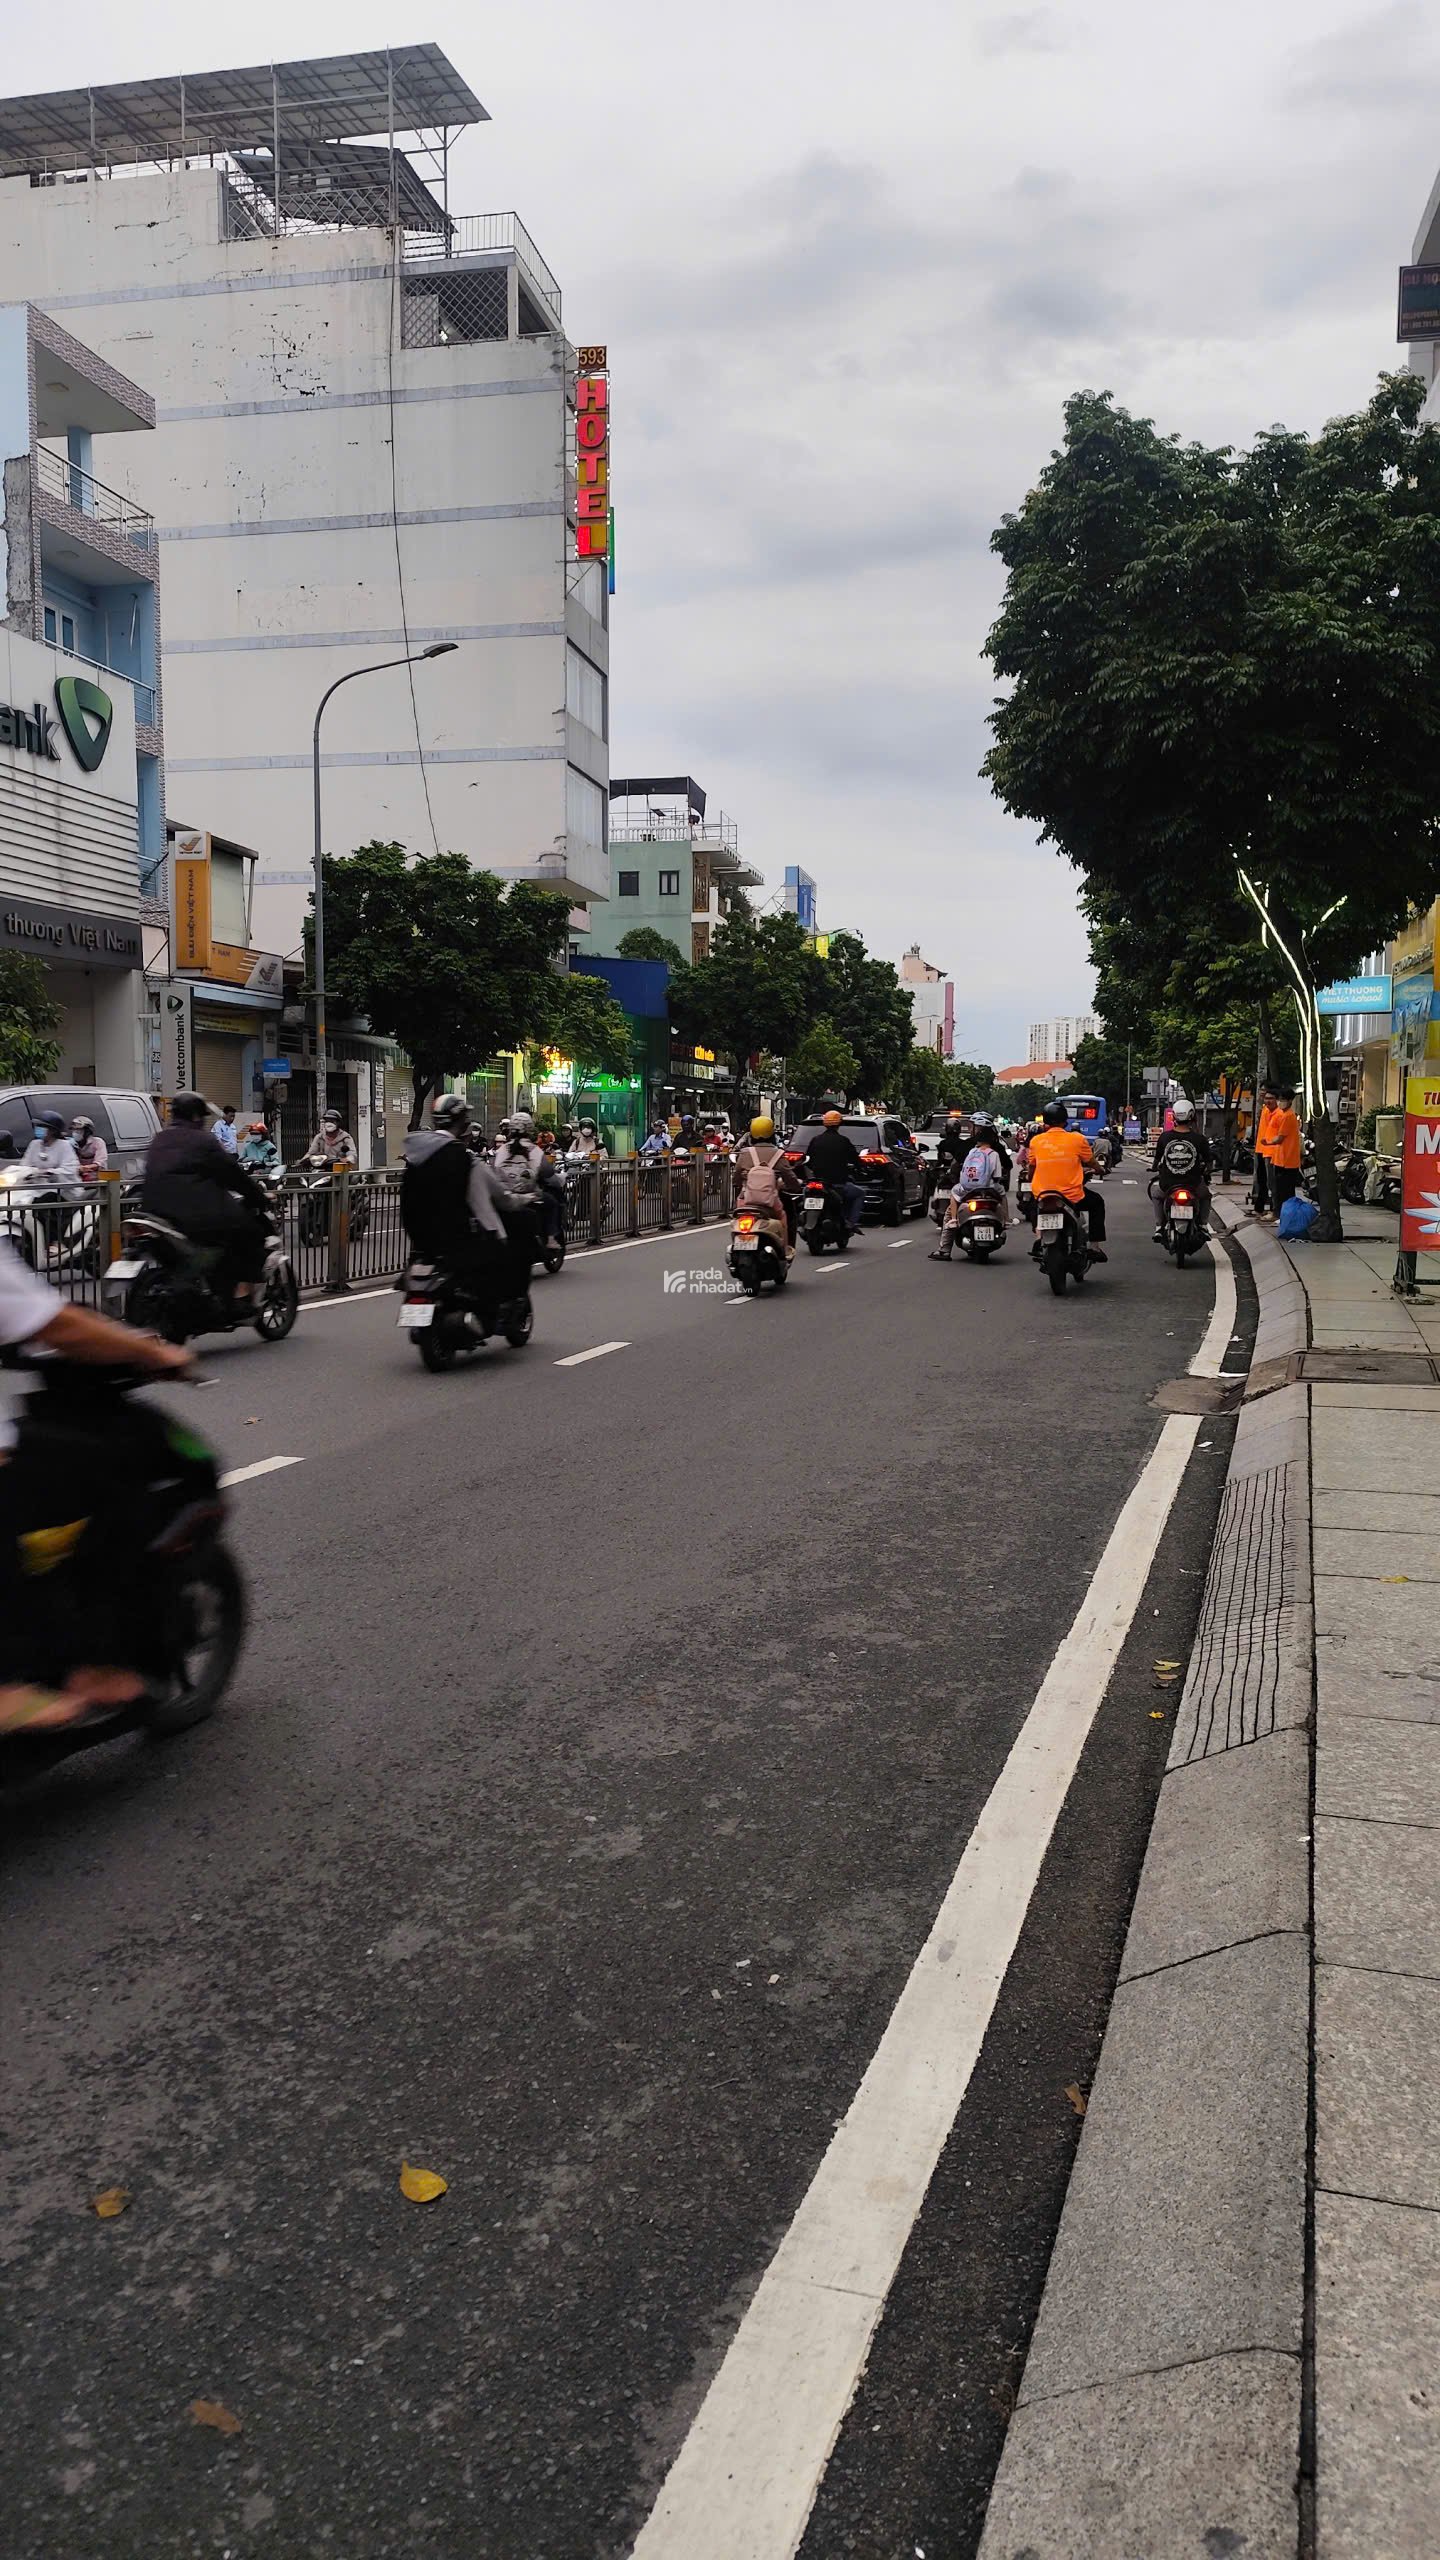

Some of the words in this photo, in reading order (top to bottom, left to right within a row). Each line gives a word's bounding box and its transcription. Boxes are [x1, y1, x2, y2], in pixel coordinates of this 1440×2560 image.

[579, 347, 605, 366] 593
[576, 378, 607, 556] HOTEL
[175, 1013, 186, 1090] Vietcombank
